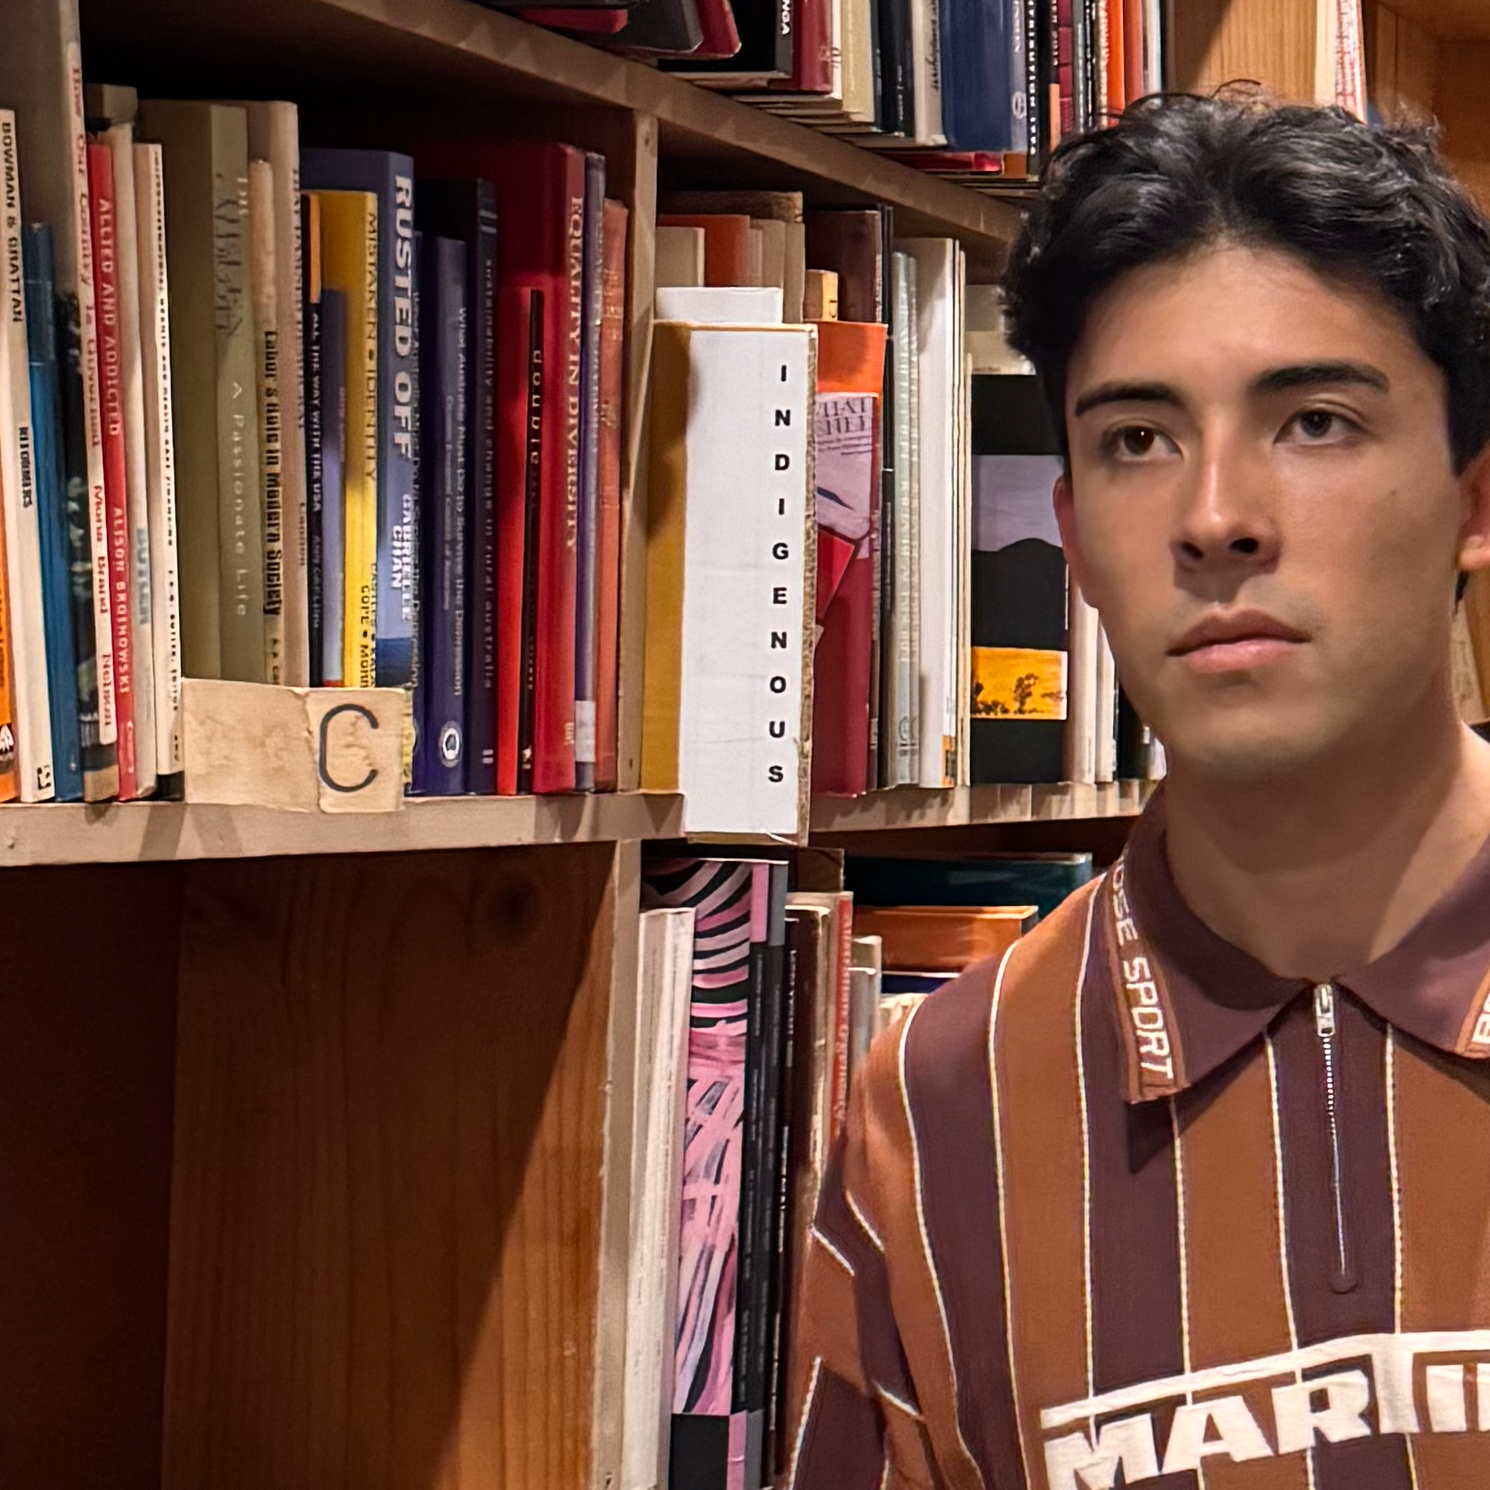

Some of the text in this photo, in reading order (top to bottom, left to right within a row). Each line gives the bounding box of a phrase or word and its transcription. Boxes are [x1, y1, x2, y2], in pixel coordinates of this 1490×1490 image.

[1, 121, 17, 208] BOWMAN
[99, 199, 121, 436] ALLIED AND ADDICTED
[365, 212, 378, 482] MISTAKEN IDENTITY
[393, 175, 413, 459] RUSTED OFF
[312, 313, 323, 512] ALL THE WAY WITH THE USA
[484, 394, 495, 430] and
[529, 349, 543, 465] double
[566, 196, 583, 553] EQUALITY IN DIVERSITY
[232, 413, 247, 554] Passionate
[265, 472, 282, 543] Modern
[482, 439, 494, 510] change
[112, 506, 130, 693] ALISON BROINOWSKI
[235, 568, 249, 616] Life
[263, 550, 283, 616] Society
[391, 525, 403, 588] CHAN
[401, 494, 413, 620] GABRIELLE
[484, 545, 495, 592] rural
[767, 364, 791, 784] INDIGENOUS
[453, 609, 465, 697] Depression
[483, 600, 495, 689] australia
[319, 703, 381, 793] C
[1111, 856, 1174, 1080] OSE SPORT
